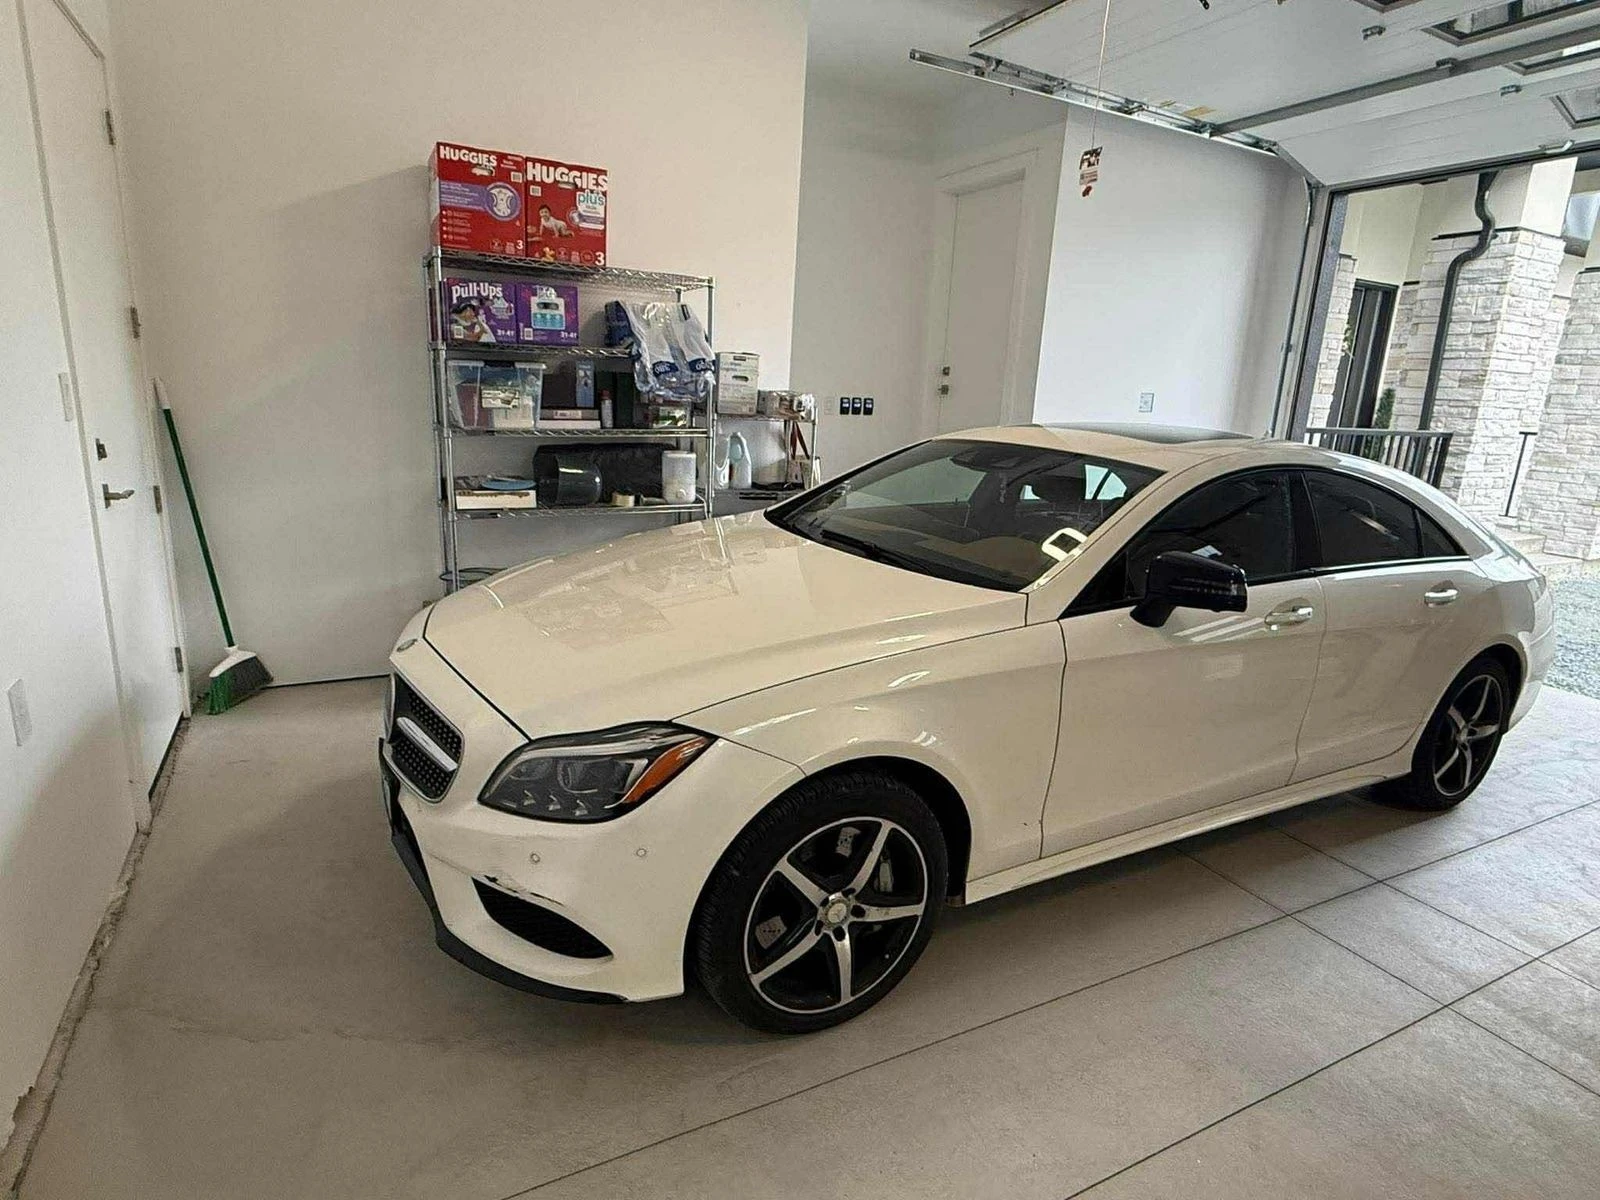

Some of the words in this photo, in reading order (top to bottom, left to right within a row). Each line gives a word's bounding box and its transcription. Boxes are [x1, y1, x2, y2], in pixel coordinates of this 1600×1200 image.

[439, 145, 498, 167] HUGGIES
[526, 161, 608, 192] HUGGIES
[578, 190, 604, 206] plus
[516, 240, 524, 250] 3
[595, 252, 605, 265] 3
